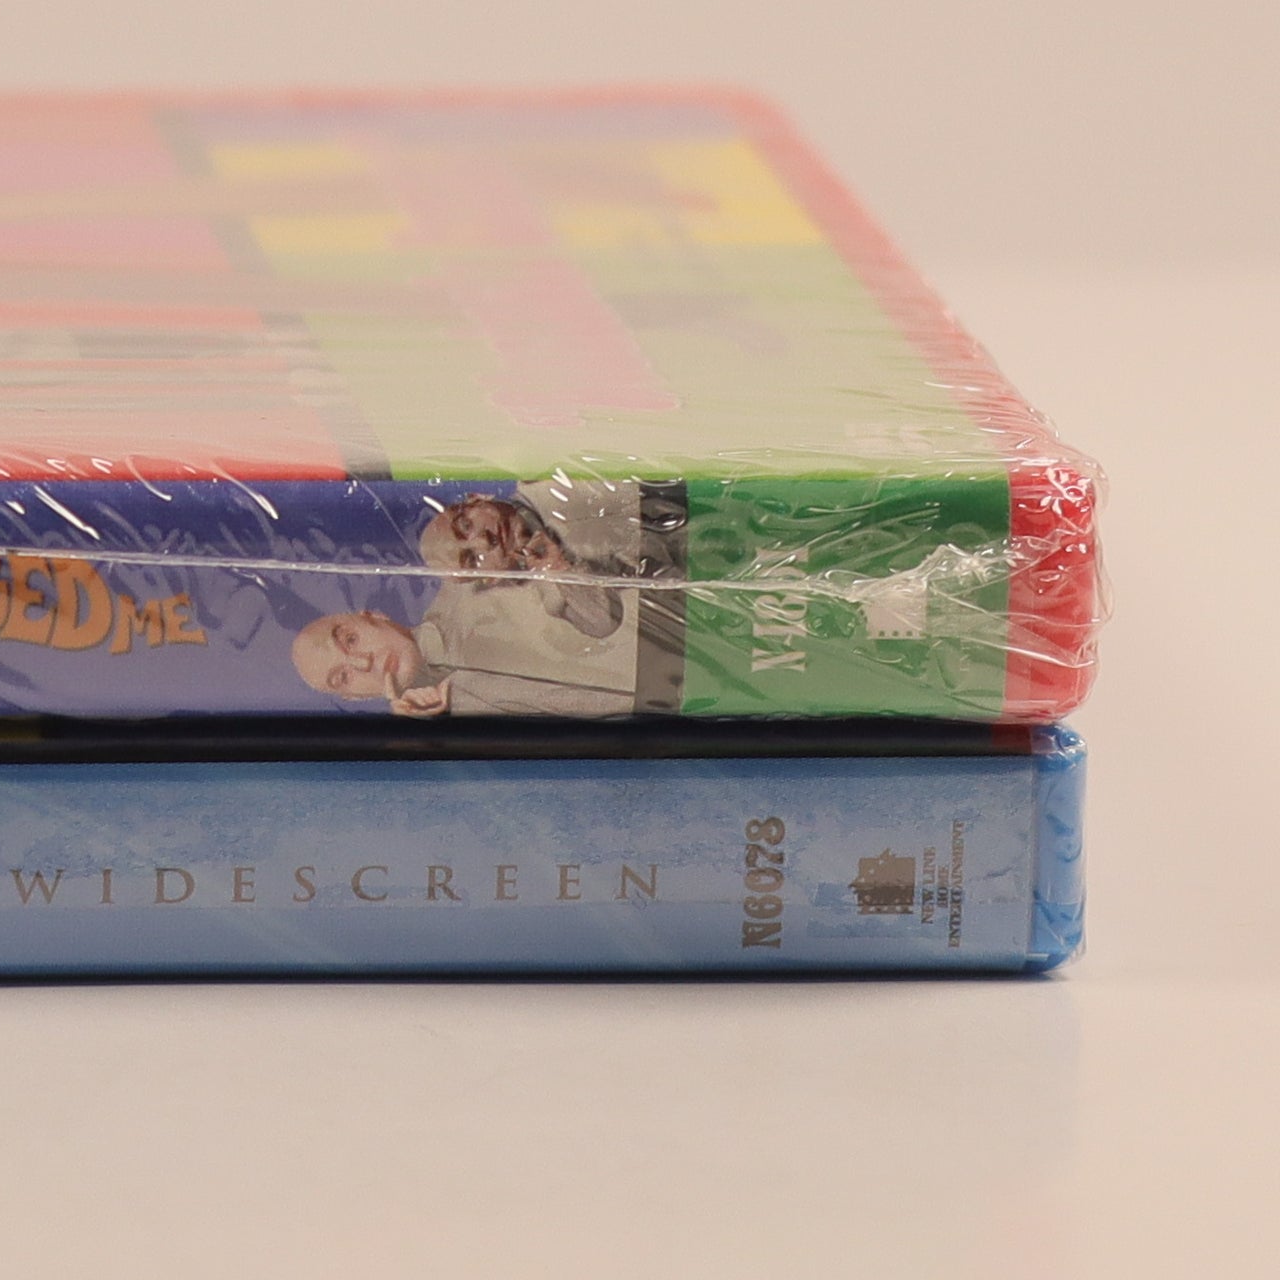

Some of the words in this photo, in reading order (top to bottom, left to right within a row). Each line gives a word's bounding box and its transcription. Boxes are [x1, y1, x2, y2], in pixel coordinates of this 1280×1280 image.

[109, 593, 208, 655] ME
[9, 862, 660, 905] WIDESCREEN
[741, 815, 787, 950] N6078
[923, 846, 936, 884] LINE
[922, 888, 934, 924] NEW
